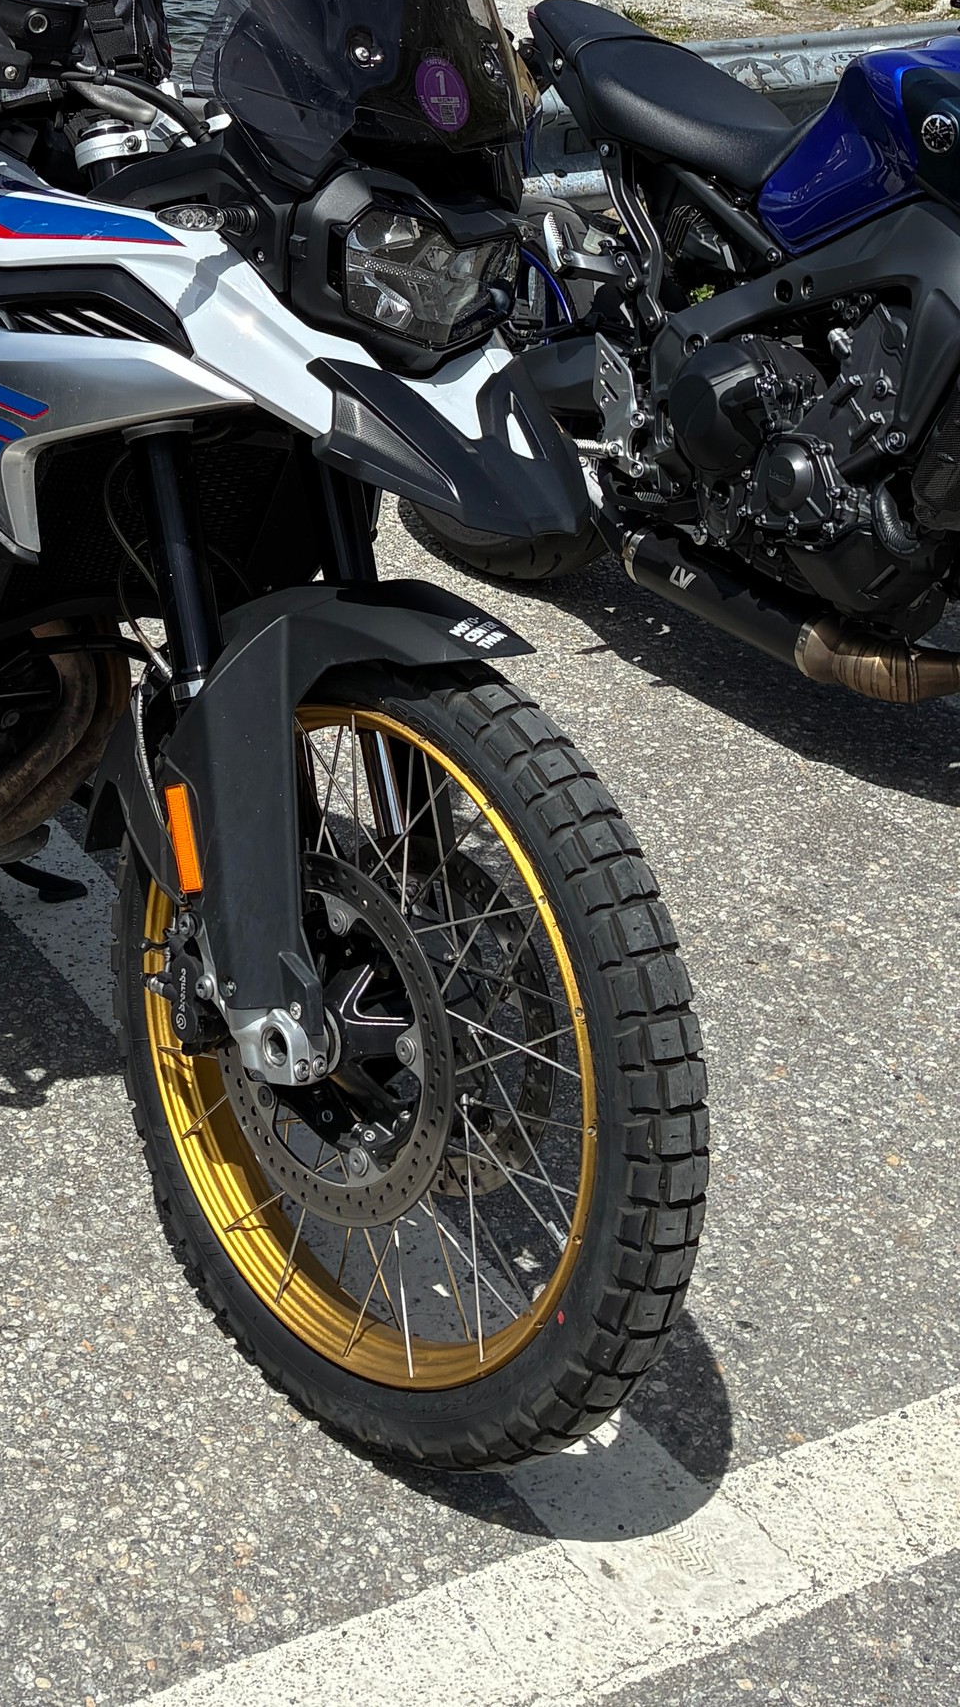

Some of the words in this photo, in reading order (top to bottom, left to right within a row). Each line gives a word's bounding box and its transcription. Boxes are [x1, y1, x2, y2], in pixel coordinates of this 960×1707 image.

[435, 70, 447, 96] 1
[669, 565, 697, 590] LV
[178, 967, 187, 1012] brembo
